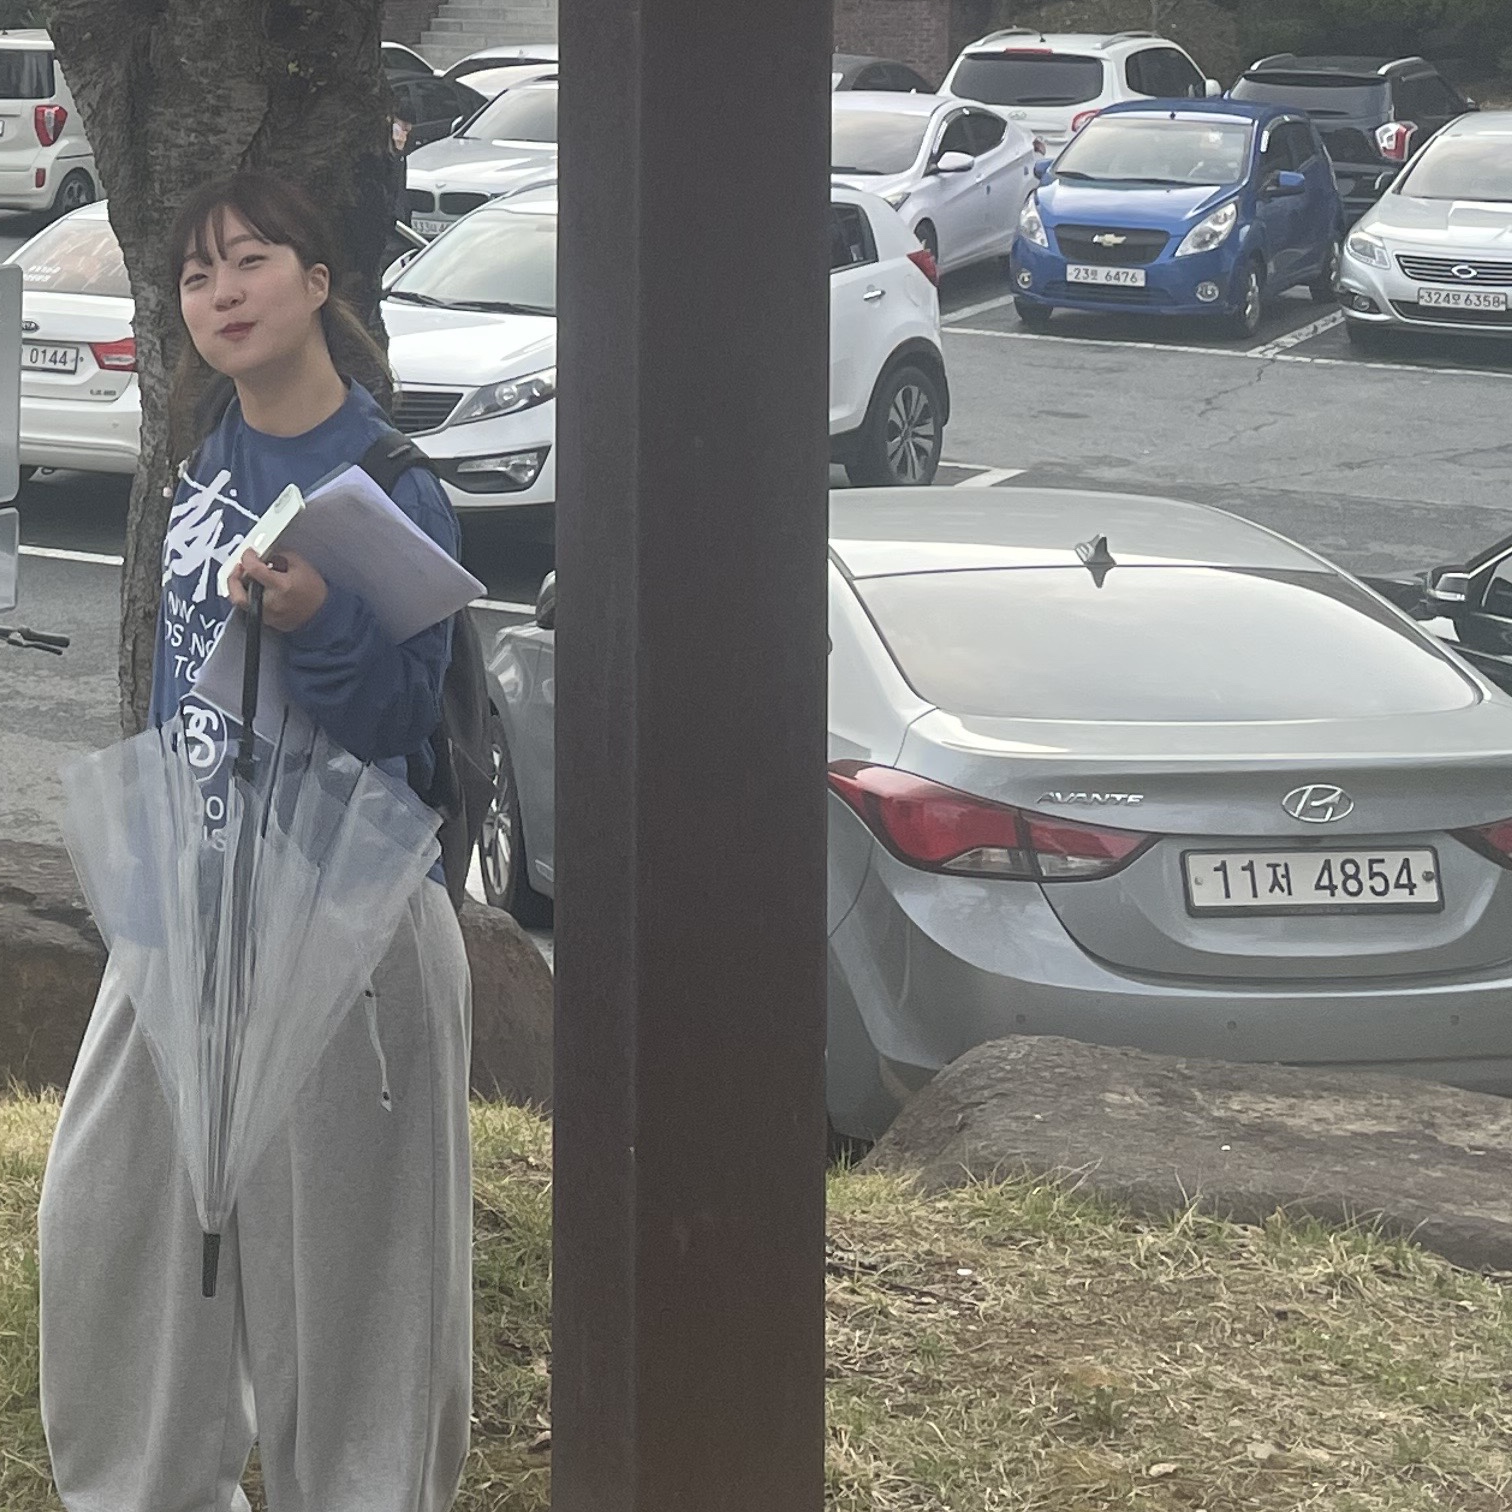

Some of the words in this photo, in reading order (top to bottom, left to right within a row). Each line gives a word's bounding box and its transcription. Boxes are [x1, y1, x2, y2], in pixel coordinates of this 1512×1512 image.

[1104, 270, 1138, 284] 6476
[1464, 293, 1501, 308] 6358
[29, 347, 68, 366] 0144
[1036, 791, 1145, 806] AVANTE
[1213, 859, 1293, 899] 11저
[1313, 857, 1418, 898] 4854
